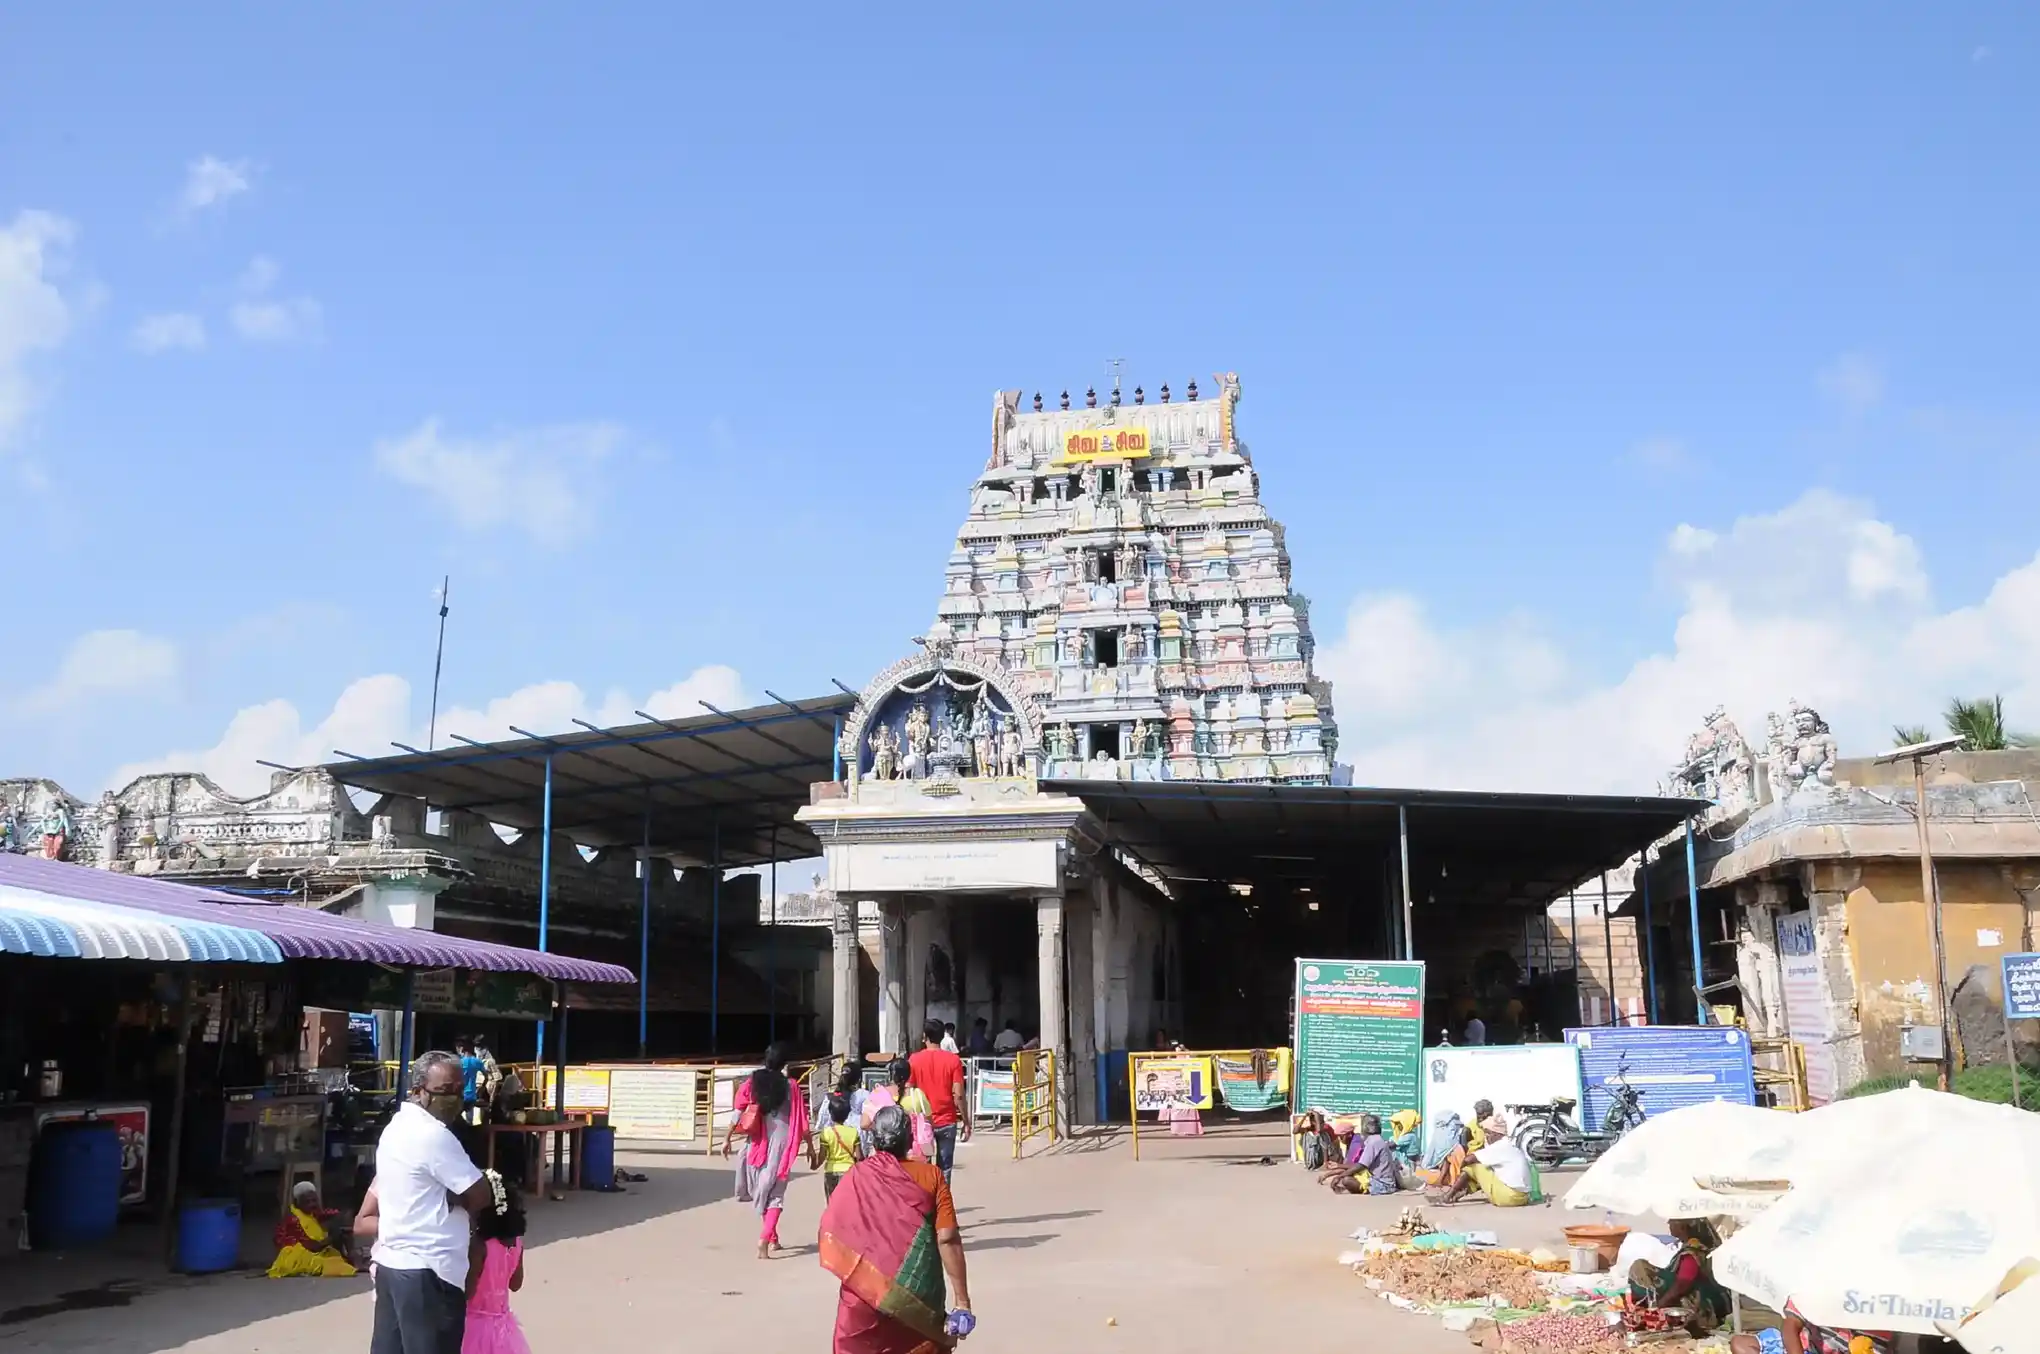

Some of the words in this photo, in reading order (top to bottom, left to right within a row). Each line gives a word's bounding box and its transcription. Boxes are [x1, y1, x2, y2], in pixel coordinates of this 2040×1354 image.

[1067, 434, 1098, 455] சிவ
[1116, 431, 1145, 451] சிவ
[1842, 1289, 1876, 1314] Sri
[1878, 1293, 1957, 1321] Thaila
